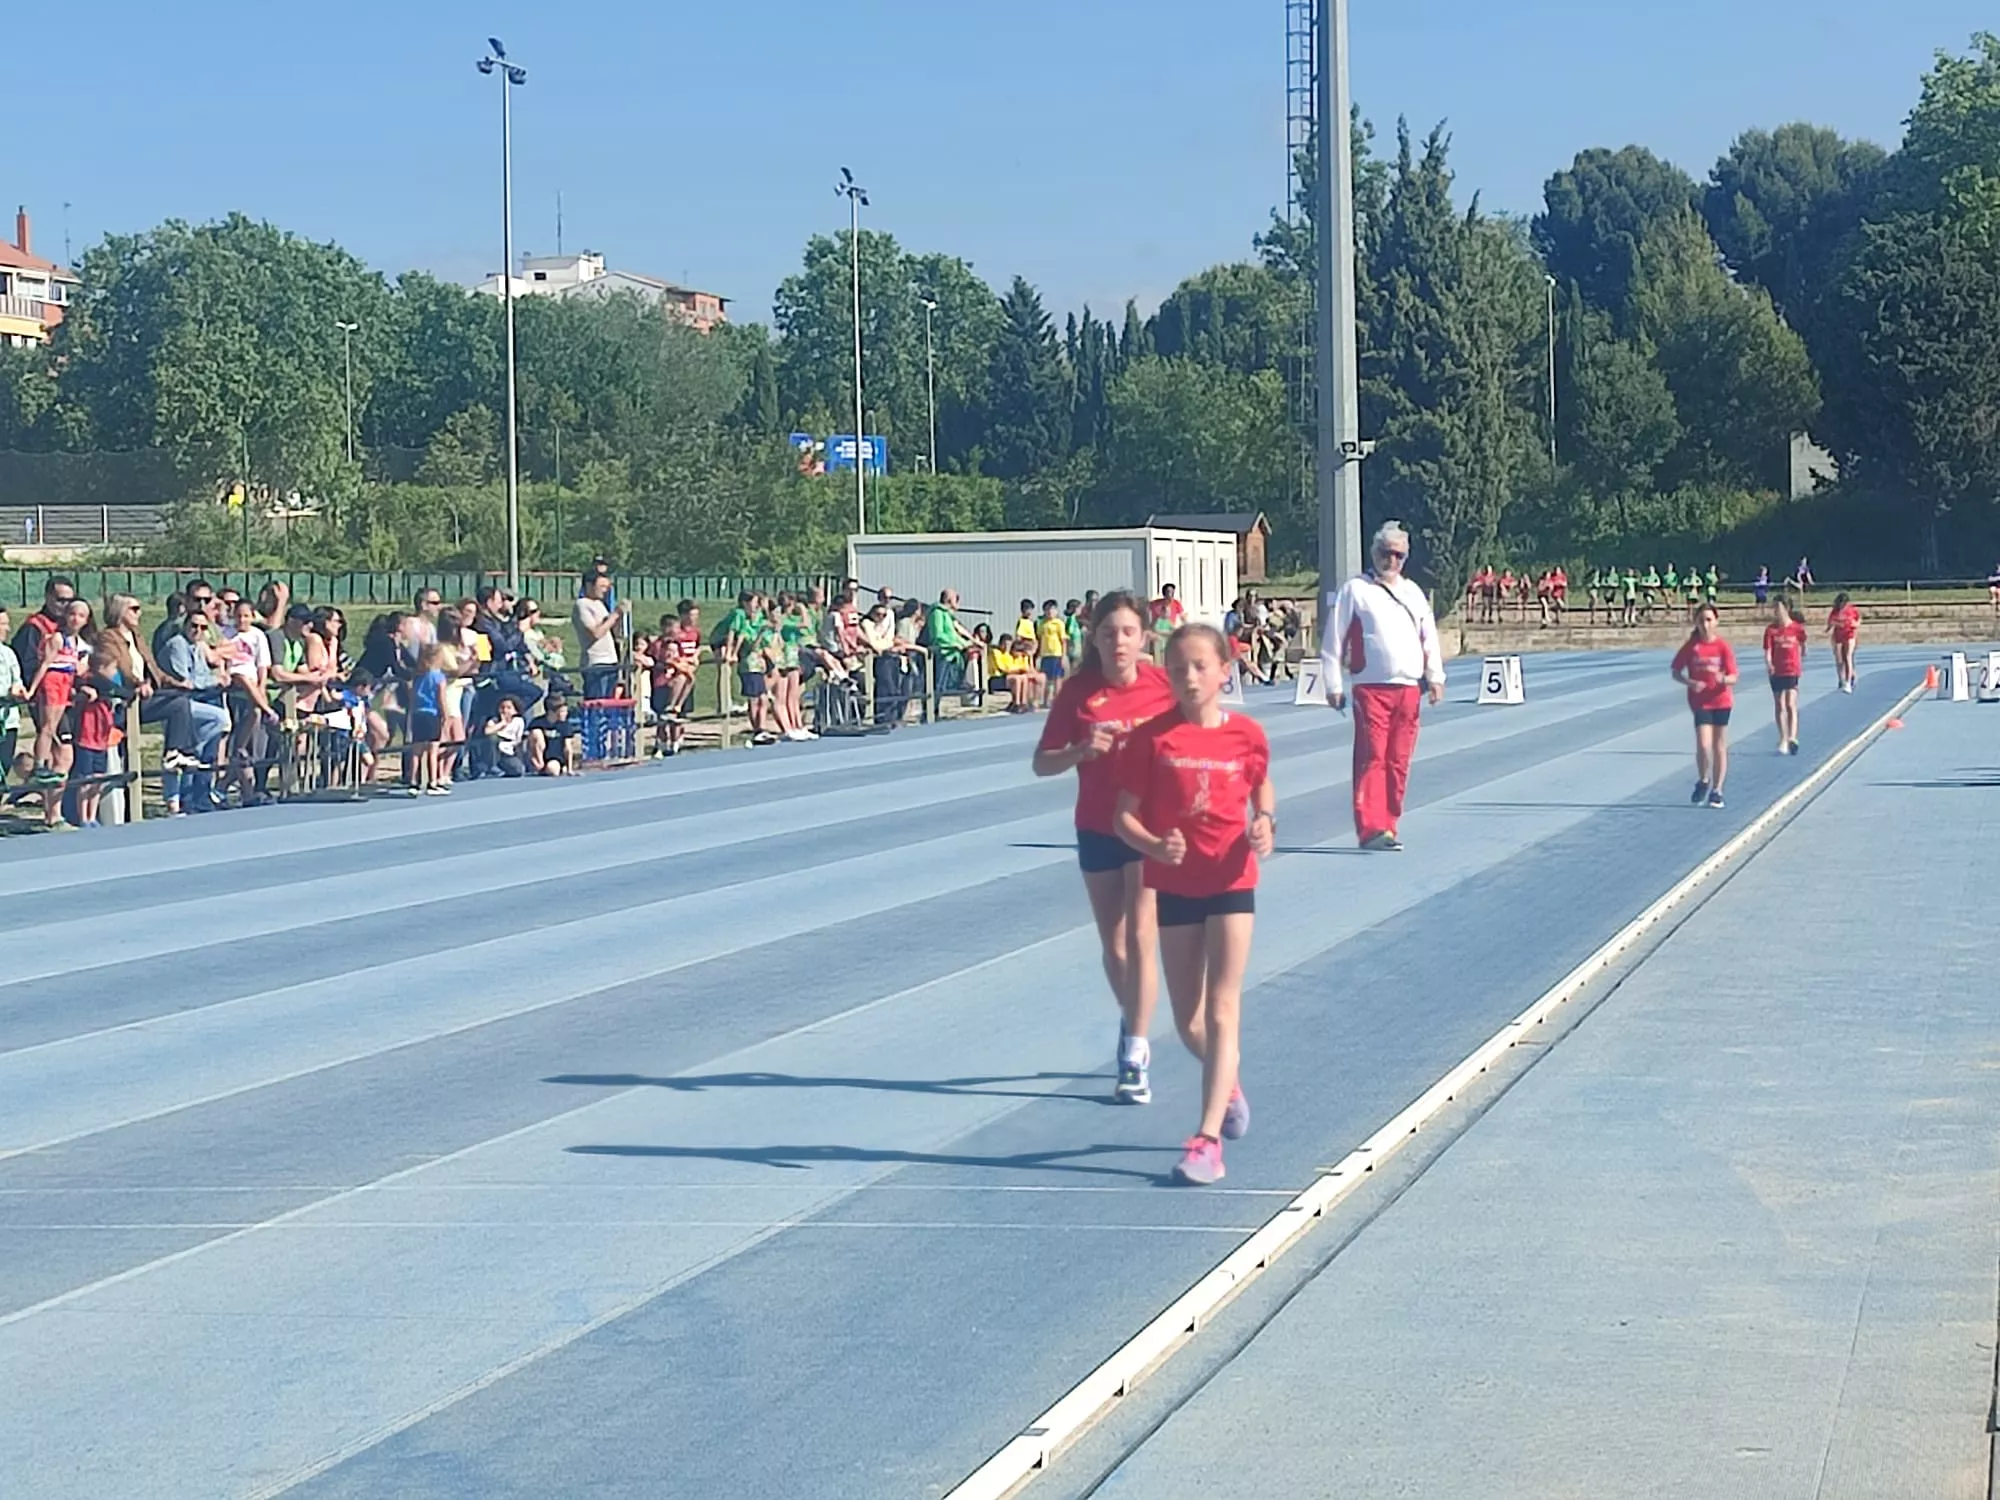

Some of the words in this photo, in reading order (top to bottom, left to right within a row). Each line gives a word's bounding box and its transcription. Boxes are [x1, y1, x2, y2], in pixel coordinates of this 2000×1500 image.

[1305, 672, 1318, 695] 7
[1487, 671, 1502, 694] 5
[1943, 667, 1949, 690] 1
[1980, 666, 1988, 689] 2
